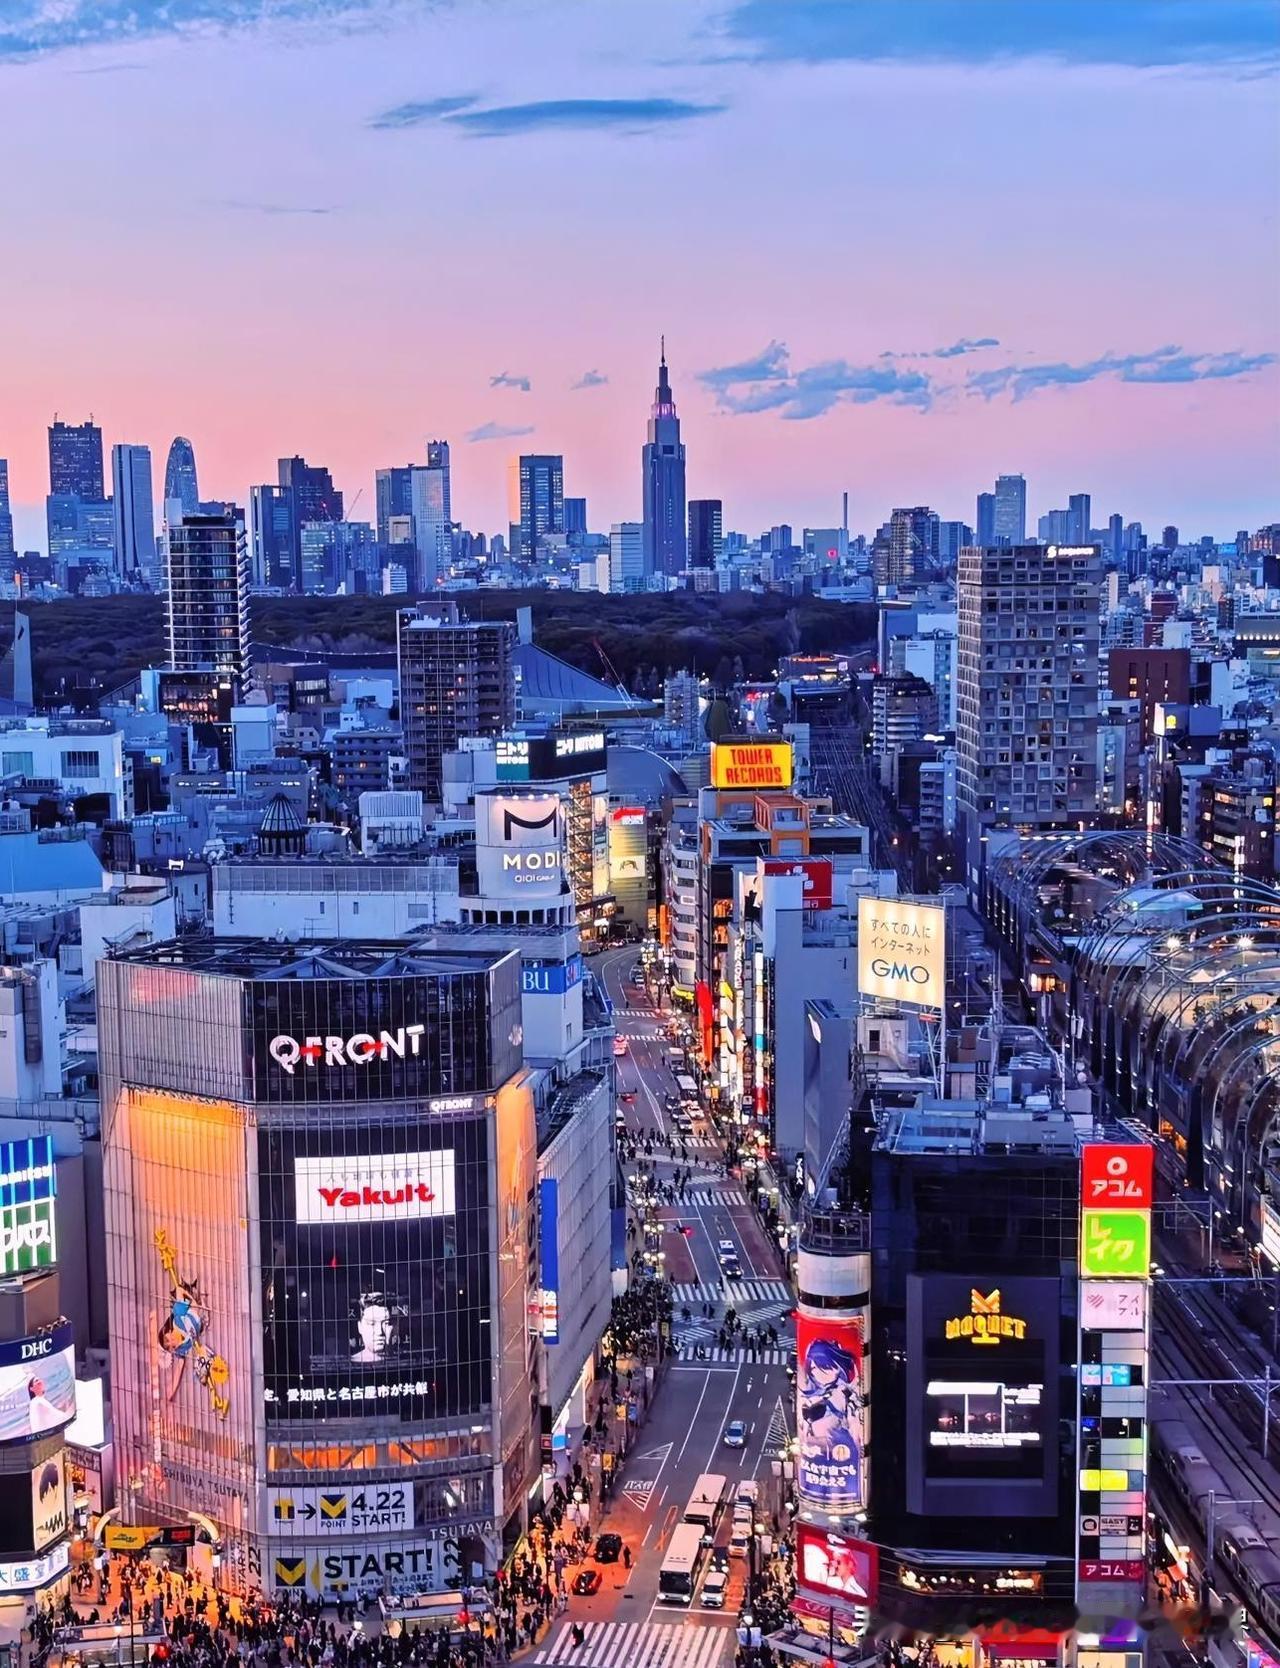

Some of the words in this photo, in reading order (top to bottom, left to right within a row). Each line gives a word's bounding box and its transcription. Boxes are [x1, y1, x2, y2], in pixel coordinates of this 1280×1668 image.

[496, 742, 529, 755] ニトリ
[730, 749, 773, 765] TOWER
[726, 767, 782, 784] RECORDS
[503, 850, 560, 870] MODI
[871, 919, 932, 939] すべての人に
[871, 936, 931, 956] インターネット
[871, 958, 930, 984] GMO
[269, 1024, 425, 1074] QFRONT
[318, 1183, 435, 1207] Yakult
[1091, 1179, 1143, 1197] アコム
[21, 1338, 53, 1359] DHC
[164, 1467, 205, 1490] SHIBUYA
[208, 1480, 249, 1505] TSUTAYA
[351, 1489, 406, 1511] 4.22
[321, 1520, 346, 1528] POINT
[351, 1511, 406, 1527] START!
[429, 1519, 493, 1539] TSUTAYA
[324, 1548, 433, 1579] START!
[1085, 1564, 1125, 1576] アコム
